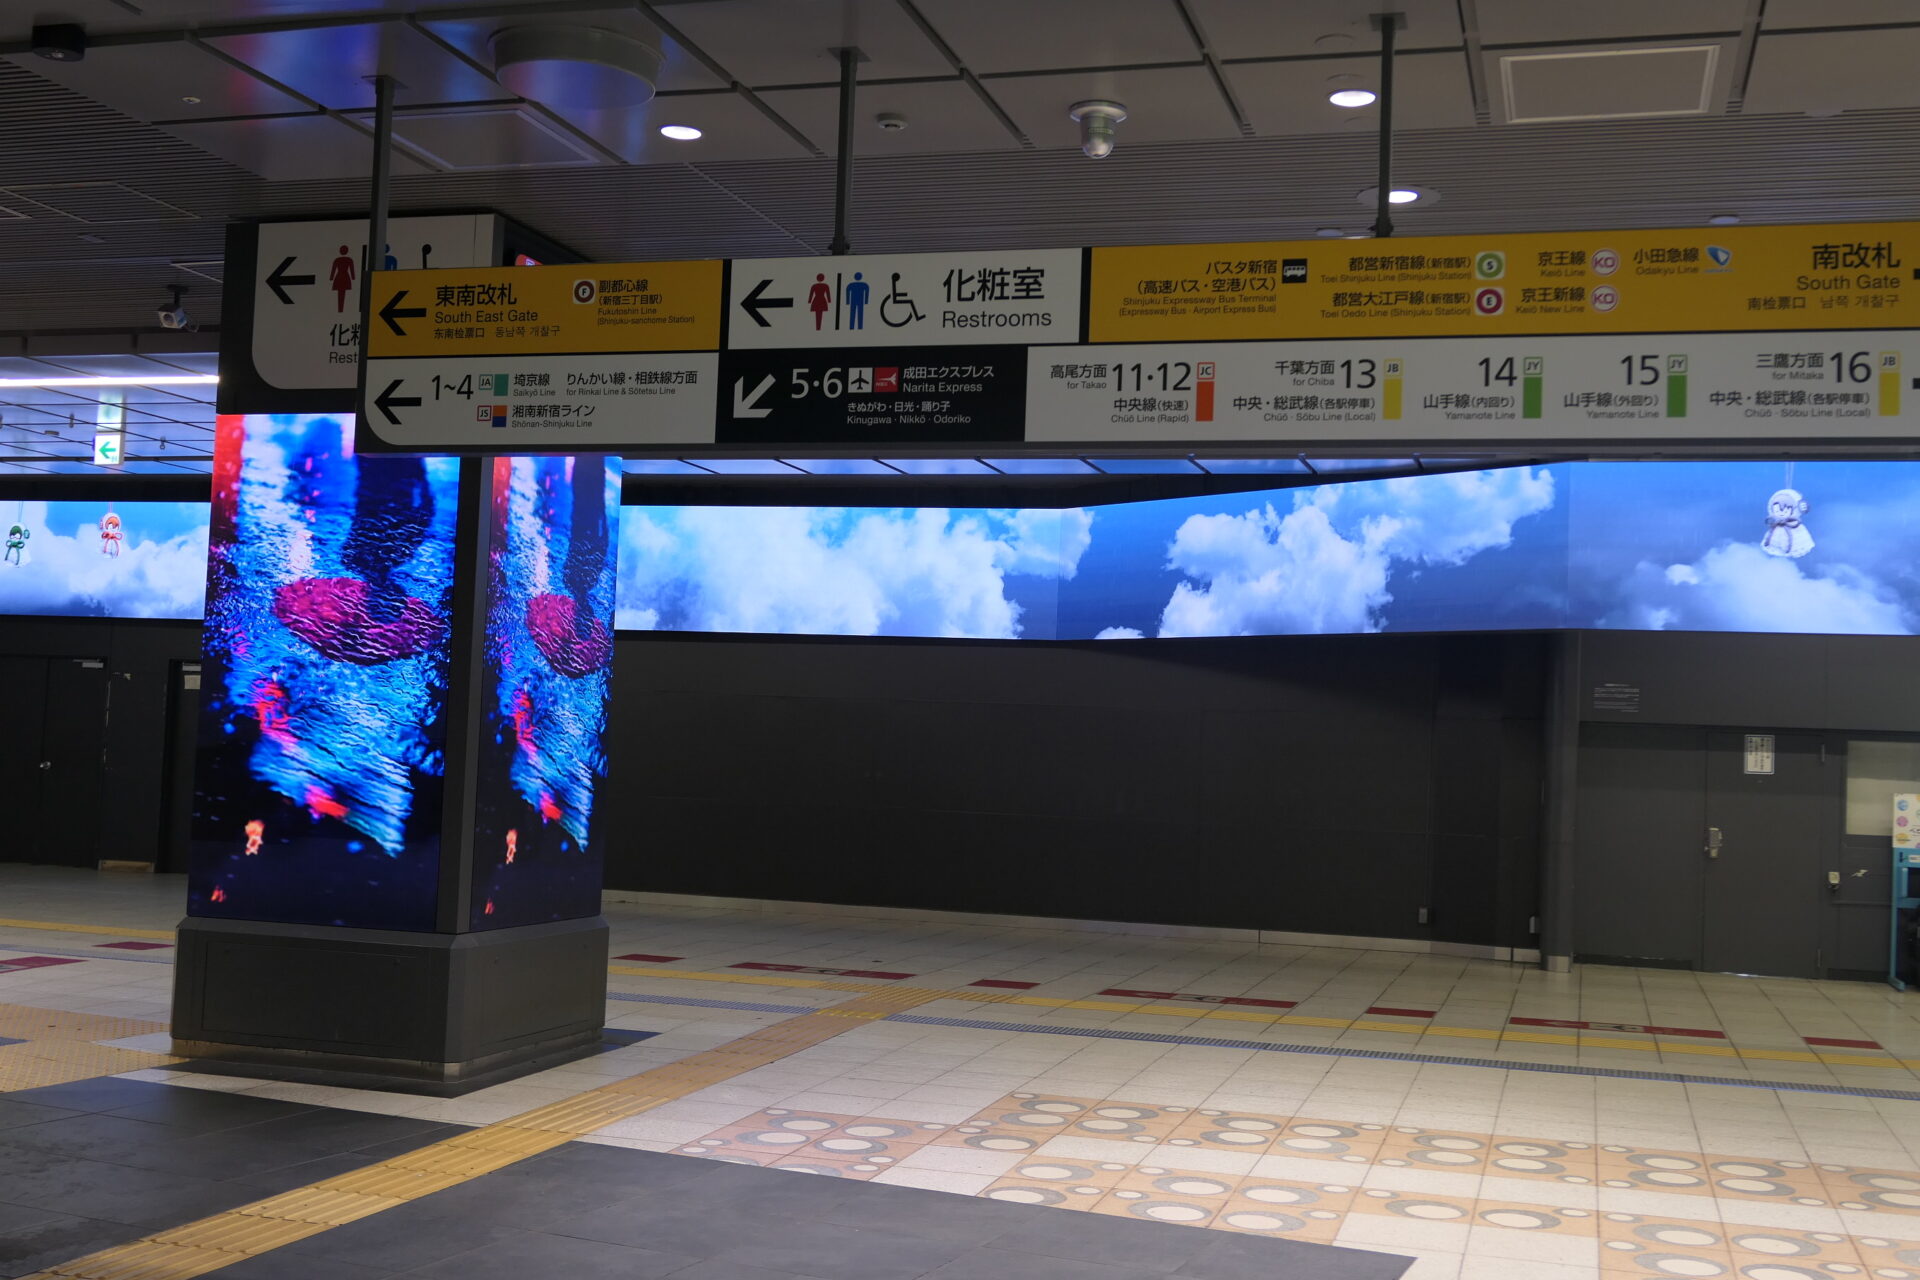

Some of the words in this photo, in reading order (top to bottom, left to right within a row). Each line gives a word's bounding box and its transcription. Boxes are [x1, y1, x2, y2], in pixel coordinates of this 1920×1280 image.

[1538, 251, 1586, 267] 京王線
[1634, 248, 1699, 264] 小田急線
[1812, 242, 1900, 270] 南改札
[1206, 260, 1277, 274] バスタ新宿
[1636, 266, 1675, 276] Odakyu
[1678, 266, 1699, 274] Line
[1341, 275, 1376, 283] Shinjuku
[1399, 273, 1436, 282] (Shinjuku
[1439, 271, 1472, 280] Station)
[1797, 276, 1850, 291] South
[1857, 274, 1900, 289] Gate
[599, 279, 648, 293] 副都心線
[943, 267, 1044, 303] 化粧室
[436, 283, 517, 307] 東南改札
[599, 294, 662, 306] （新宿三丁目駅）
[1123, 298, 1160, 308] Shinjuku
[1163, 297, 1216, 307] Expressway
[1239, 294, 1276, 302] Terminal
[1522, 287, 1585, 303] 京王新線
[1748, 296, 1805, 310] 南检票口
[1821, 296, 1848, 309] 남쪽
[1856, 295, 1899, 308] 개찰구
[1119, 306, 1169, 317] (Expressway
[1193, 305, 1221, 315] Airport
[1223, 305, 1256, 314] Express
[1258, 304, 1276, 313] Bus)
[1342, 310, 1366, 318] Oedo
[1390, 308, 1432, 318] (Shinjuku
[1436, 307, 1471, 316] Station)
[1564, 305, 1585, 313] Line
[435, 311, 471, 324] South
[476, 311, 503, 322] East
[508, 310, 538, 322] Gate
[598, 317, 667, 326] (Shinjuku-sanchome
[943, 311, 1051, 328] Restrooms
[434, 328, 484, 339] 东南检票口
[496, 327, 525, 338] 동남쪽
[530, 326, 560, 337] 개찰구
[1757, 353, 1824, 368] 三鷹方面
[904, 366, 994, 379] 成田エクスプレス
[1051, 364, 1107, 379] 高尾方面
[1275, 360, 1335, 375] 千葉方面
[1340, 358, 1376, 388] 13
[1479, 357, 1517, 387] 14
[1622, 355, 1659, 385] 15
[1831, 352, 1871, 383] 16
[514, 373, 550, 386] 埼京線
[568, 371, 697, 385] りんかい線・相鉄線方面
[1308, 378, 1335, 386] Chiba
[1772, 372, 1786, 380] for
[1790, 372, 1824, 380] Mitaka
[513, 389, 538, 398] Saikyō
[903, 383, 935, 392] Narita
[939, 382, 982, 394] Express
[512, 405, 595, 418] 湘南新宿ライン
[848, 401, 950, 412] きぬがわ・日光・踊り子
[1811, 409, 1833, 417] Line
[1836, 408, 1871, 417] (Local)
[847, 416, 891, 426] Kinugawa
[900, 415, 925, 423] Nikkō
[934, 415, 971, 423] Odoriko
[1158, 414, 1189, 423] (Rapid)
[1323, 412, 1342, 420] Line
[1344, 412, 1375, 422] (Local)
[1587, 411, 1636, 419] Yamanote
[512, 418, 574, 429] Shōnan-Shinjuku
